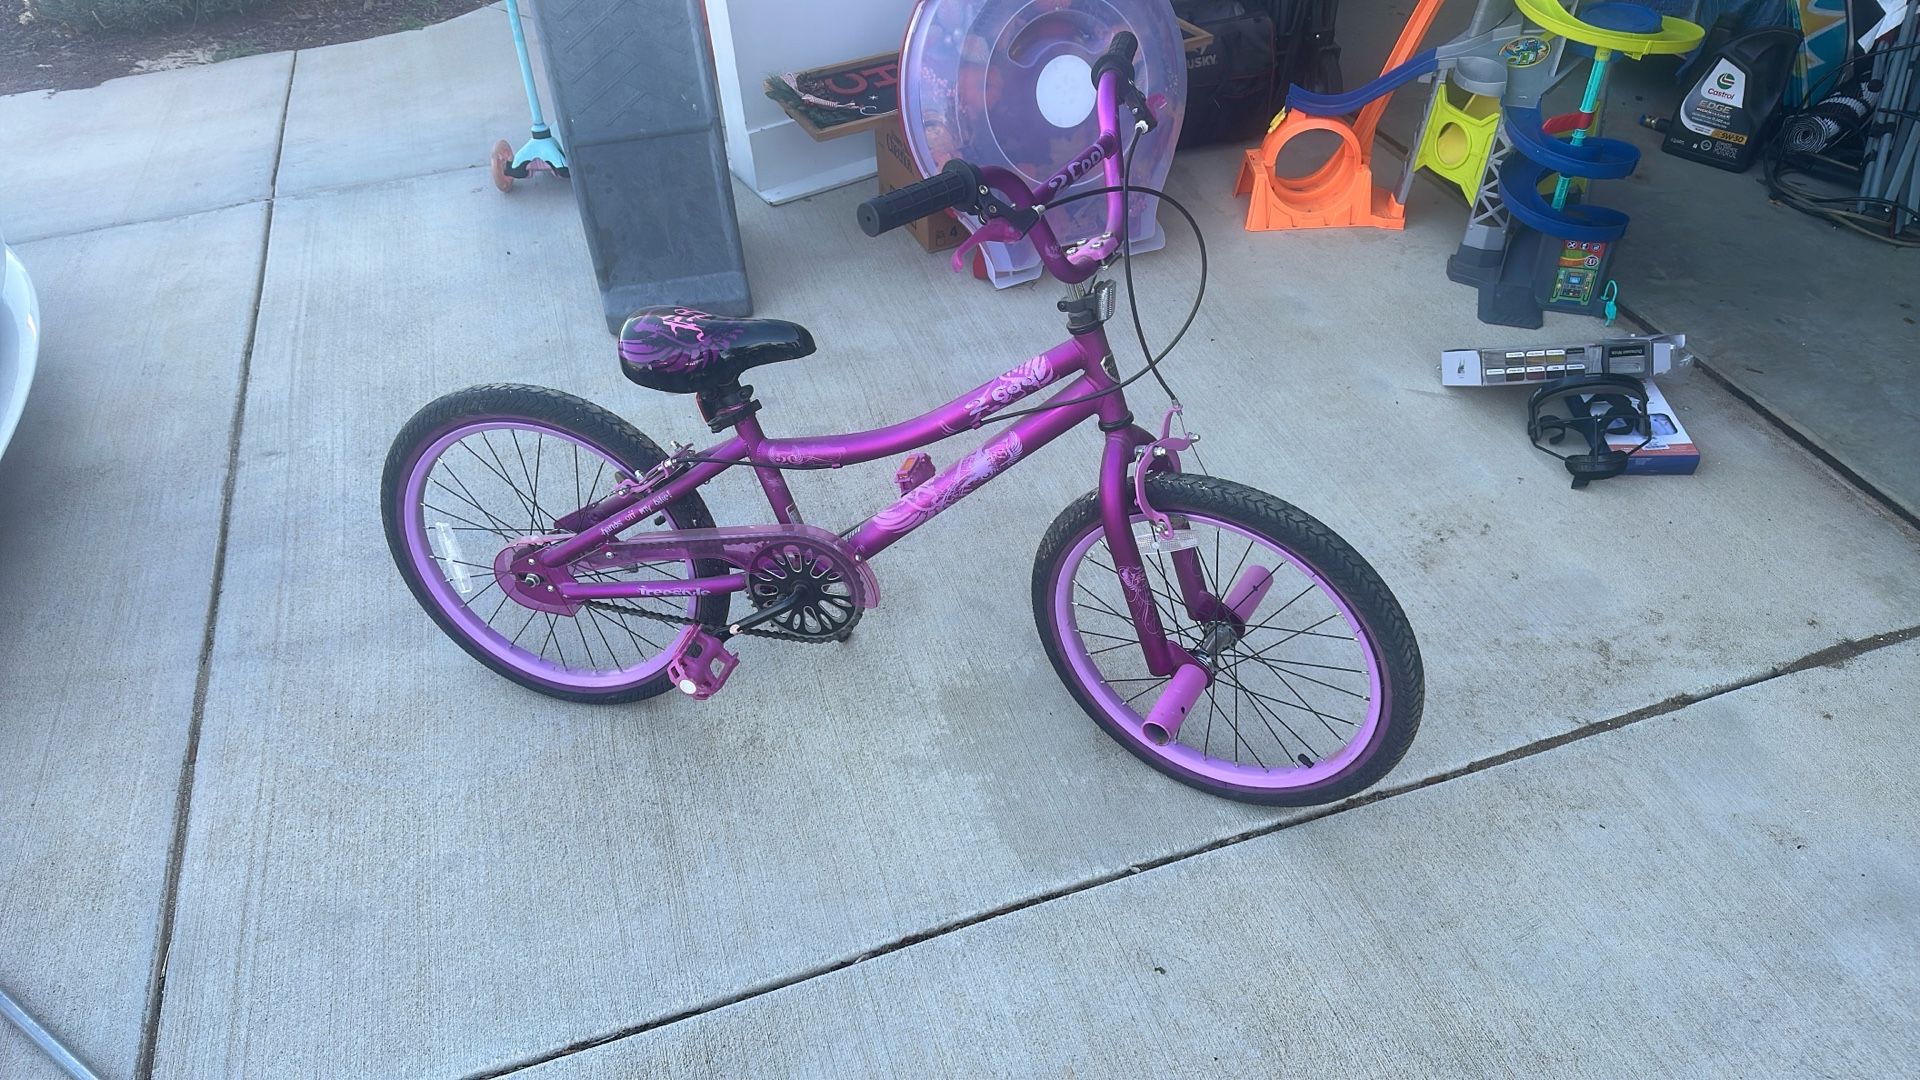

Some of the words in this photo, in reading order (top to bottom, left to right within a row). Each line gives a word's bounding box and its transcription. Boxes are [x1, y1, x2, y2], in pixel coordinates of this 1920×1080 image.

[1187, 54, 1217, 69] USKY
[1707, 88, 1735, 100] Castrol
[1699, 100, 1732, 114] EDGE
[600, 519, 623, 536] hands
[624, 509, 636, 521] off
[638, 504, 653, 515] my
[652, 489, 673, 506] bike!
